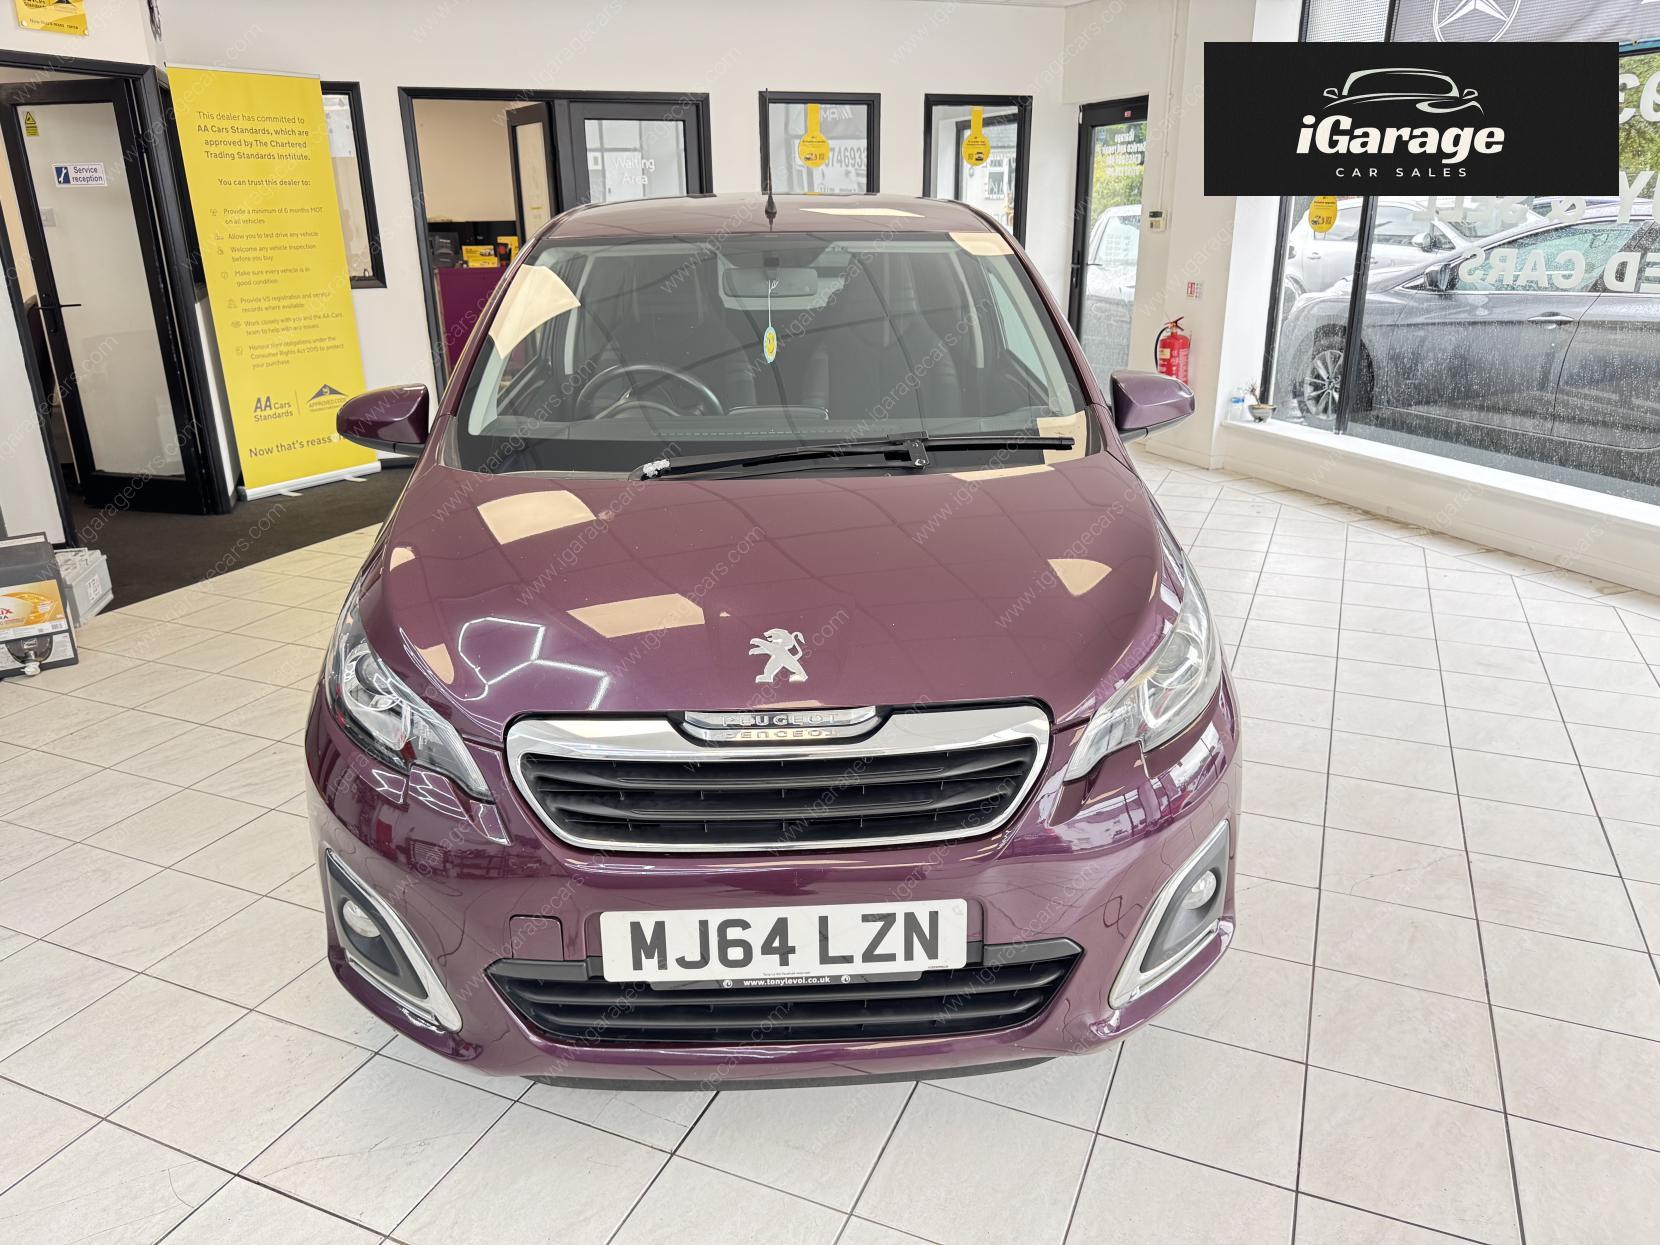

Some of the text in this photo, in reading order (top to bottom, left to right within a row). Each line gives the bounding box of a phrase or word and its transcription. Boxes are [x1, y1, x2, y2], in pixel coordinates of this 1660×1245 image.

[198, 111, 304, 124] This dealer has committed to
[211, 125, 229, 134] Cars
[230, 126, 273, 136] Standards,
[274, 128, 296, 136] which
[204, 138, 242, 148] approved
[244, 139, 253, 148] by
[270, 140, 307, 149] Chartered
[204, 151, 236, 160] Trading
[237, 152, 276, 160] Standards
[74, 166, 98, 174] Service
[614, 157, 655, 172] Waiting
[72, 176, 103, 184] reception
[218, 178, 232, 186] You
[623, 172, 648, 185] Area
[254, 396, 272, 413] AA
[254, 410, 294, 422] Standards
[249, 446, 274, 458] Now
[276, 440, 304, 452] that's
[721, 713, 839, 727] PEUGEOT
[630, 911, 939, 971] MJ64 LZN
